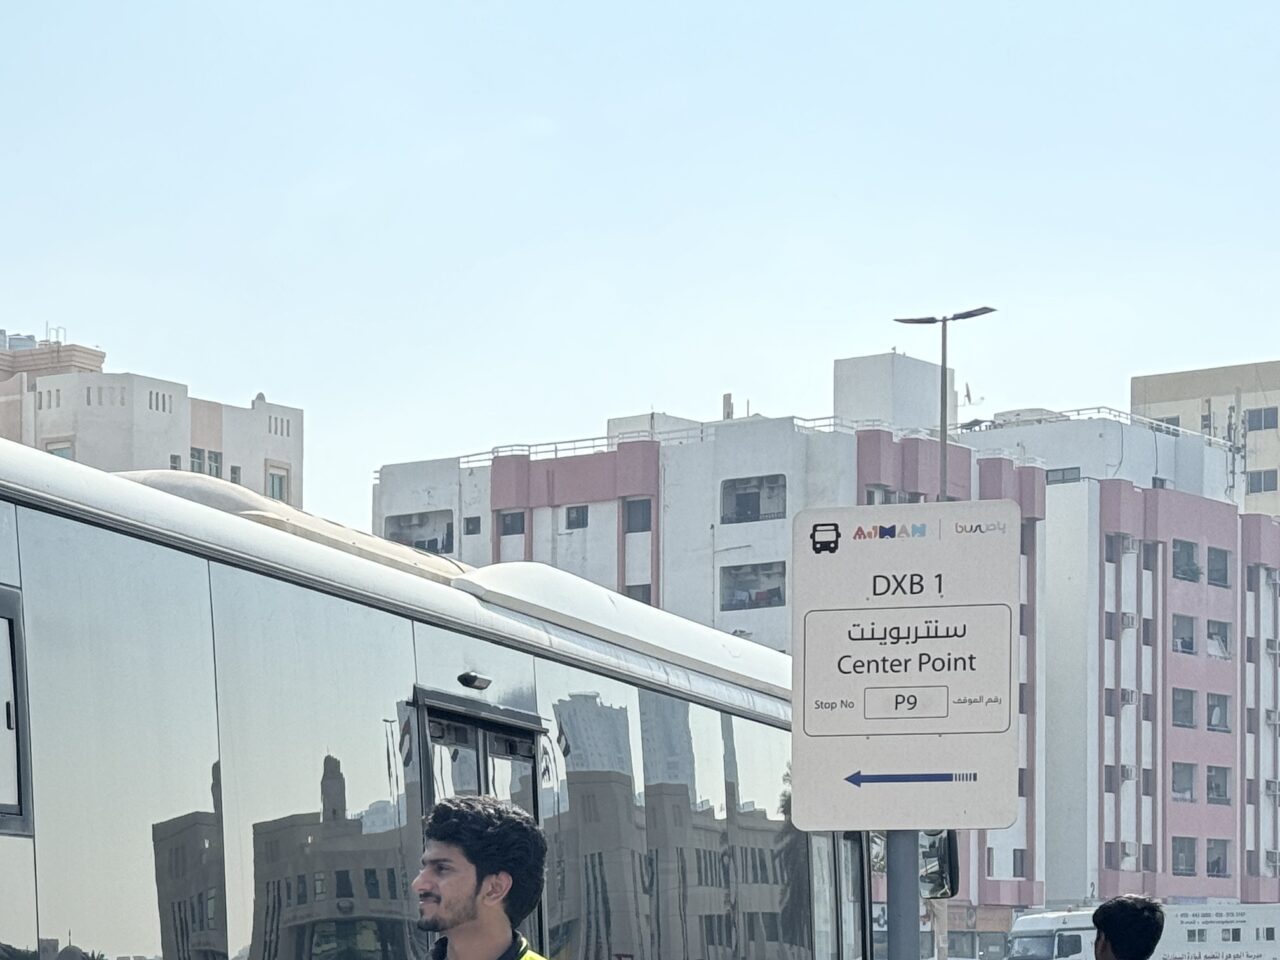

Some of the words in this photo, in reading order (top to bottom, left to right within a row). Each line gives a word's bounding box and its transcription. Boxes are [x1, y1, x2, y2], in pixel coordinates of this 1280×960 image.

[873, 574, 925, 596] DXB
[934, 574, 944, 594] 1
[847, 620, 967, 646] سنتربوينت
[837, 655, 911, 675] Center
[918, 652, 977, 673] Point
[814, 699, 837, 712] Stop
[839, 698, 855, 709] No
[894, 694, 918, 711] P9
[952, 694, 984, 705] الموقف
[985, 695, 1002, 706] رقم
[1090, 881, 1095, 898] 2
